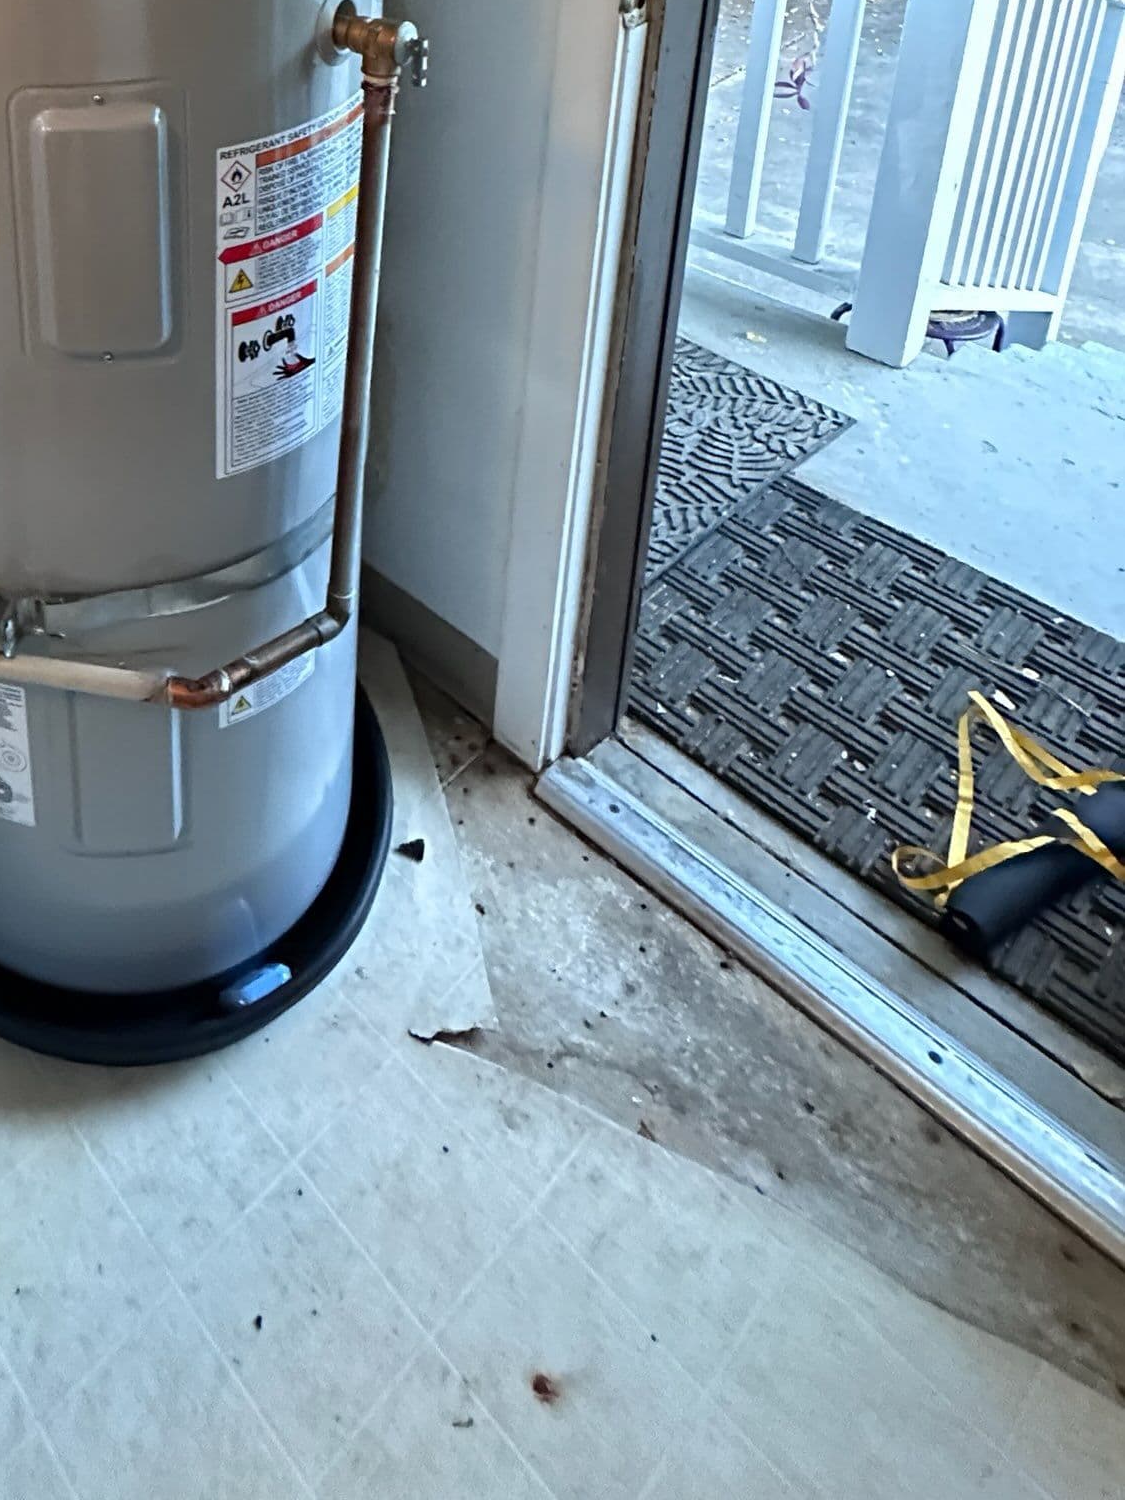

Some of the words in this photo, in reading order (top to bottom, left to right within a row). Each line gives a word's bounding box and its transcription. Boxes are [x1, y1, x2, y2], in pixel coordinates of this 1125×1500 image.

[220, 135, 286, 161] REFRIGERANT
[287, 124, 315, 141] SAFETY
[223, 193, 250, 208] A2L
[262, 230, 298, 250] DANGER
[267, 290, 302, 312] DANGER
